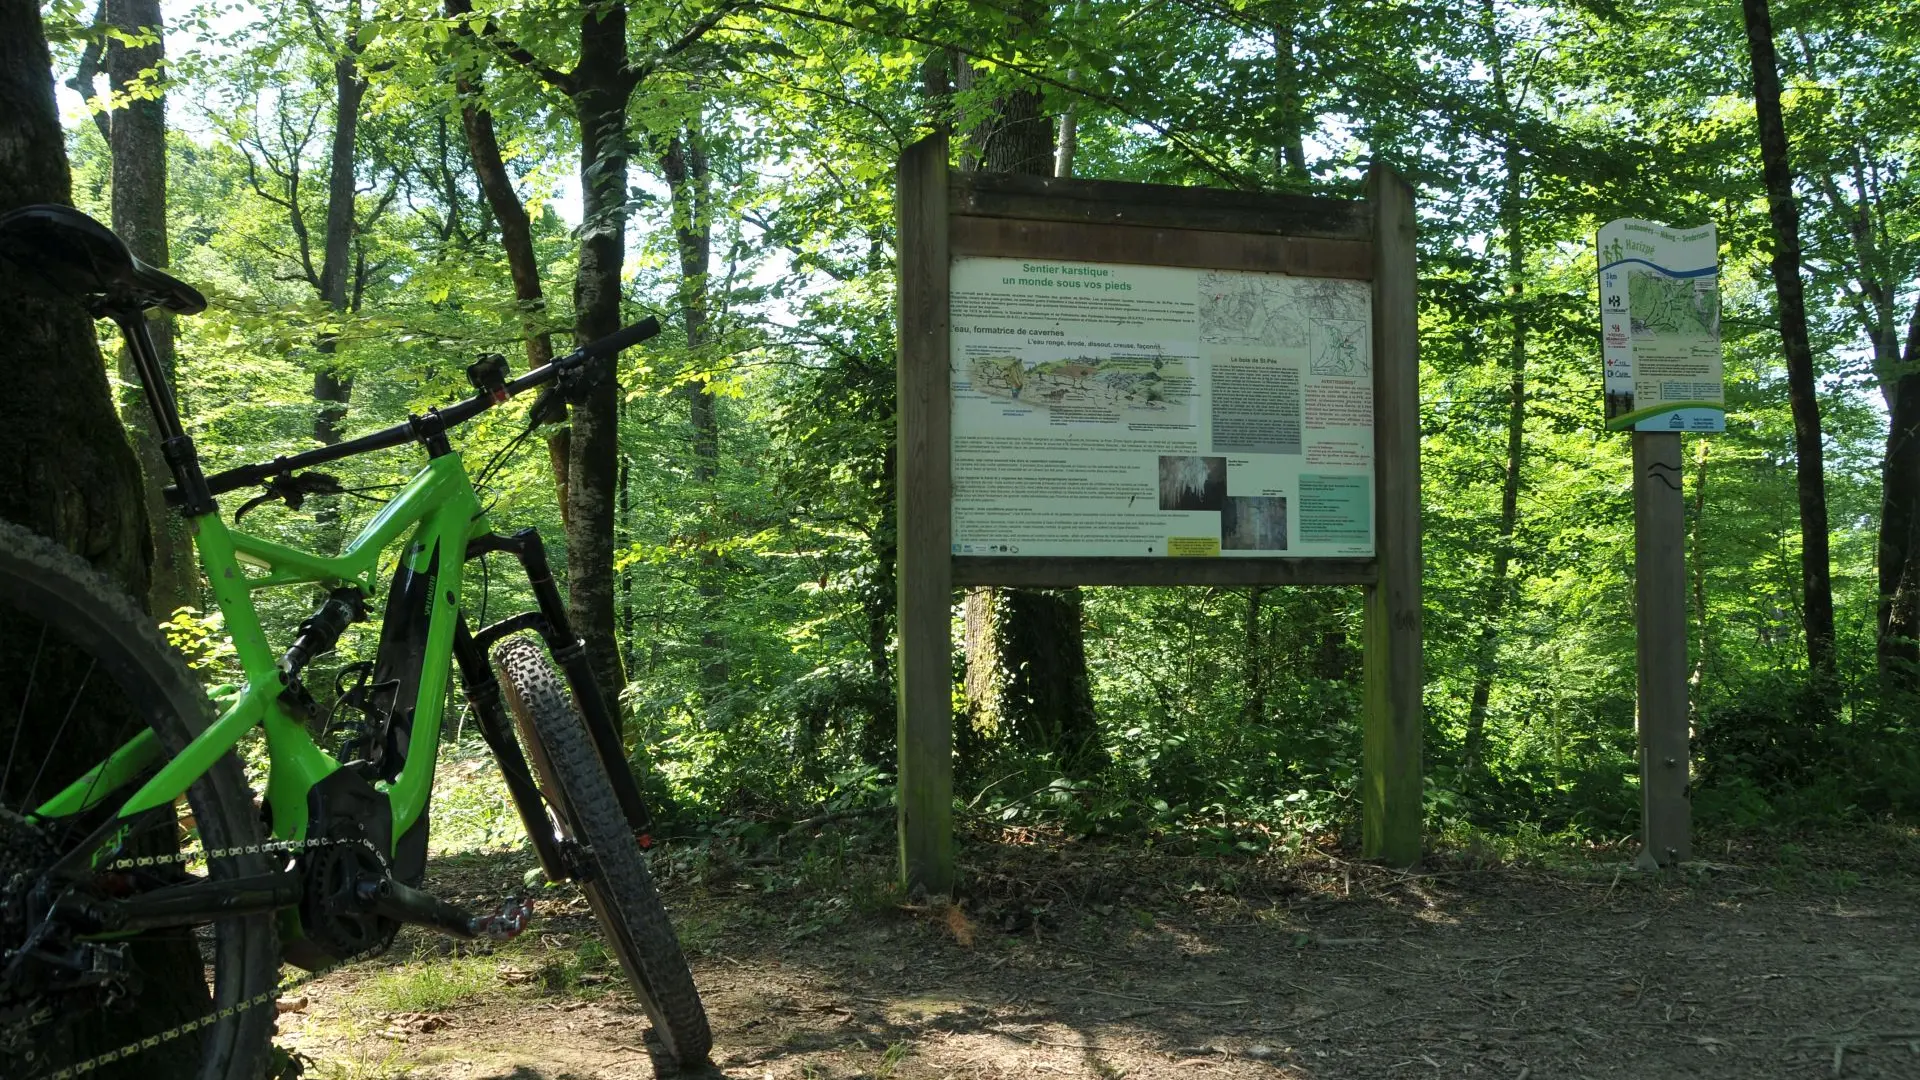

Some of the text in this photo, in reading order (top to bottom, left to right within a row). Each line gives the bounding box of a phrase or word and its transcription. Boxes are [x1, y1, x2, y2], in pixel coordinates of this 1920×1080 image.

[1660, 230, 1676, 242] Hiking
[1022, 262, 1060, 275] Sentier
[1061, 263, 1109, 278] karstique
[1002, 276, 1132, 292] un monde sous vos pieds
[973, 325, 1016, 336] formatrice
[1016, 327, 1027, 336] de
[1028, 328, 1065, 338] cavernes
[1027, 338, 1045, 346] L'eau
